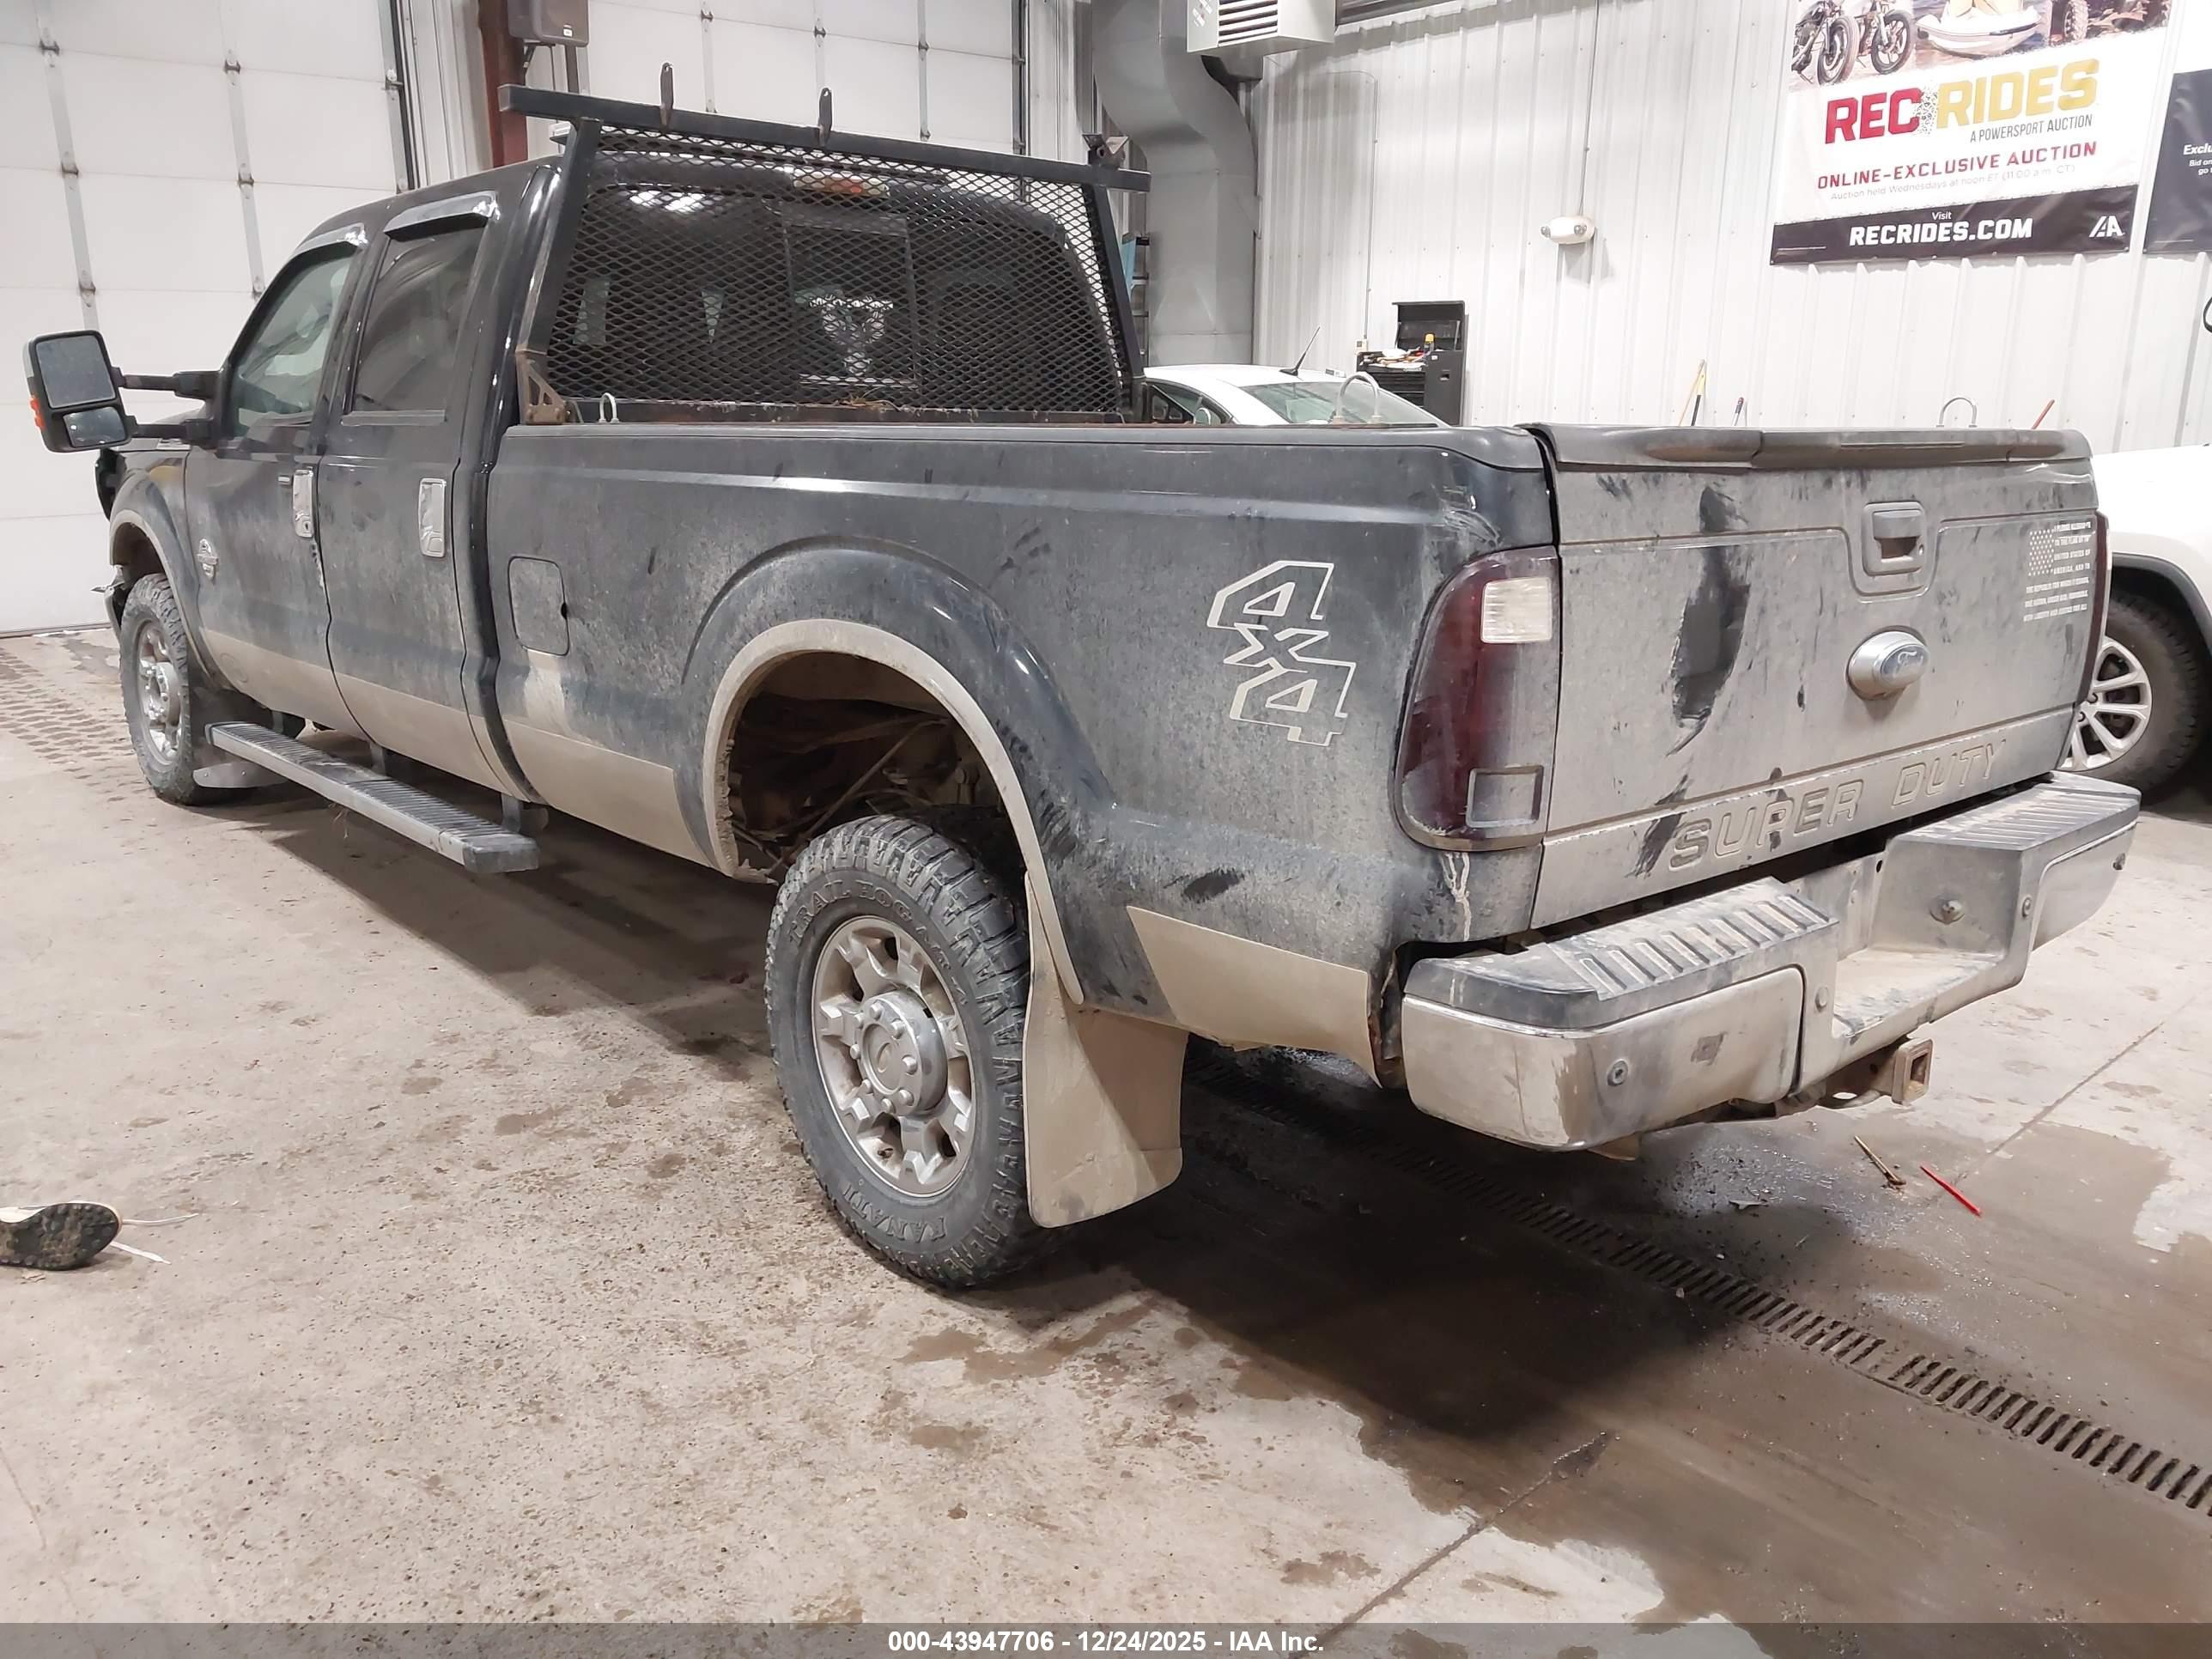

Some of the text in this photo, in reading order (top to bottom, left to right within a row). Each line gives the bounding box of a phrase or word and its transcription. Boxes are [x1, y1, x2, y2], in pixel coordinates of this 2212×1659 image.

[1825, 58, 2100, 144] REC RIDES
[1970, 113, 2093, 143] A POWERSPORT AUCTION
[1817, 141, 2098, 190] ONLINE-EXCLUSIVE AUCTION
[1831, 189, 1865, 201] Auction
[1888, 179, 1948, 194] Wednesdays
[1849, 218, 2033, 246] RECRIDES.COM
[1932, 210, 1952, 221] Visit
[1668, 738, 2007, 872] SUPER DUTY
[788, 878, 853, 944] TRAIL
[854, 879, 914, 922] HOG
